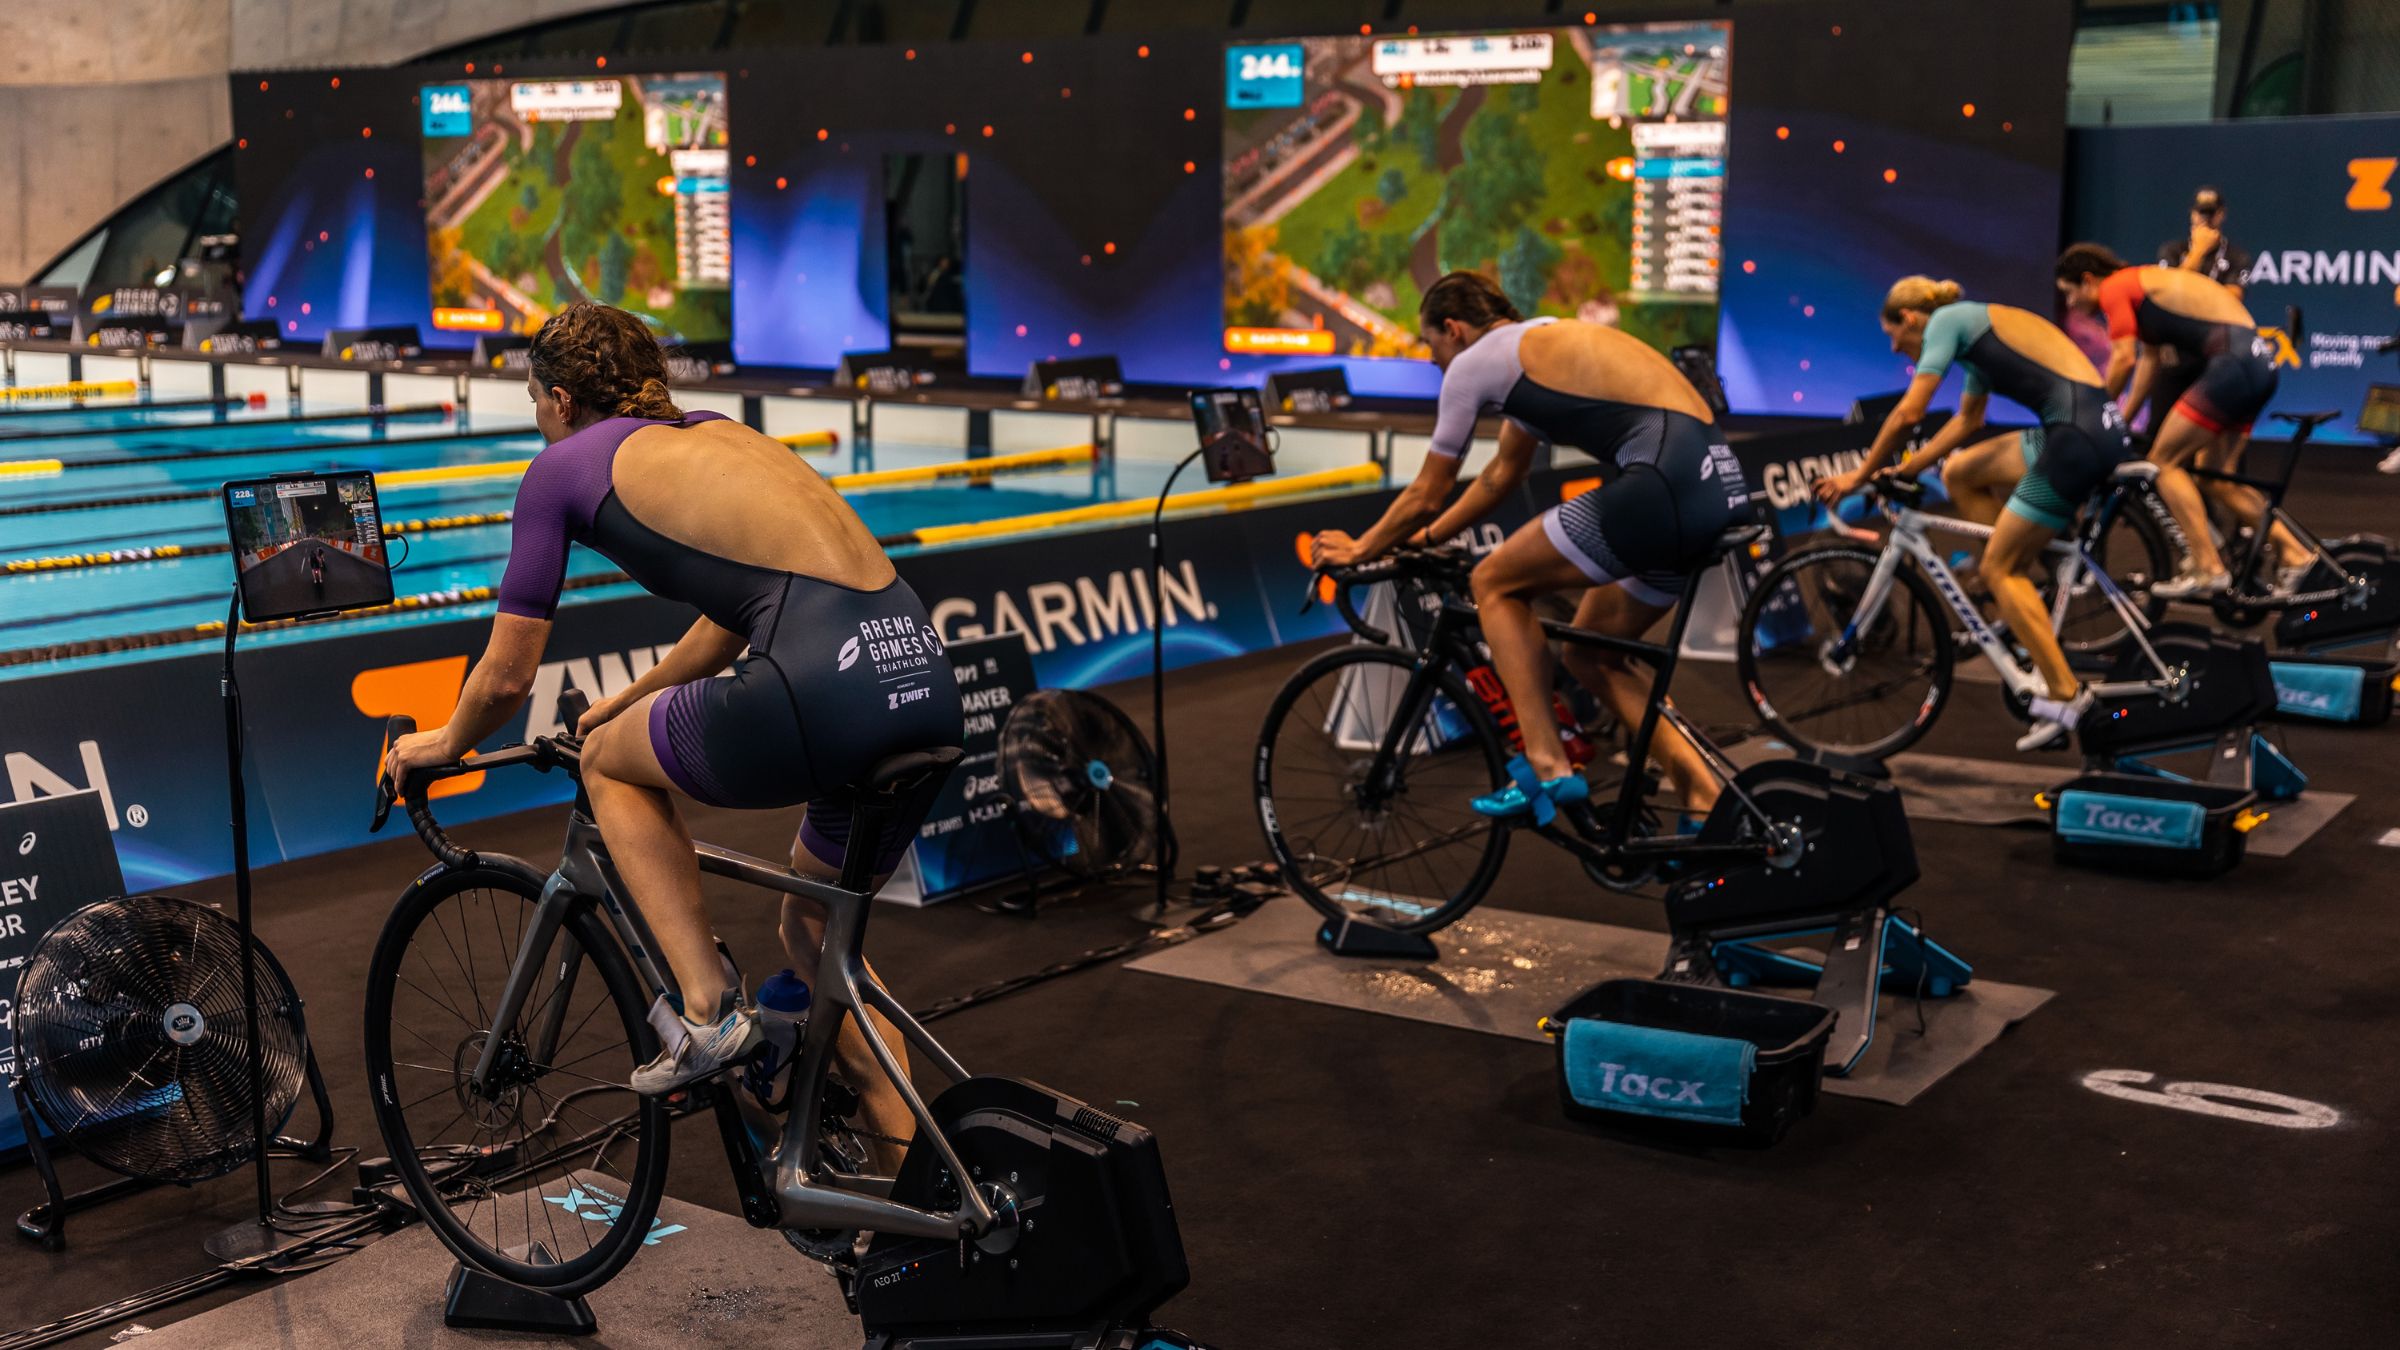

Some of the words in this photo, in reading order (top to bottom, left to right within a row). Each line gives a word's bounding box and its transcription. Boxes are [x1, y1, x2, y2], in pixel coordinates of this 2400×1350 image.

[2249, 250, 2400, 285] ARMIN
[930, 559, 1207, 654] GARMIN
[859, 616, 916, 641] ARENA
[868, 636, 923, 662] GAMES
[875, 656, 929, 675] TRIATHLON
[900, 687, 931, 704] ZWIFT
[2084, 803, 2166, 835] Tacx
[0, 875, 39, 907] EY
[1599, 1062, 1705, 1105] Tacx
